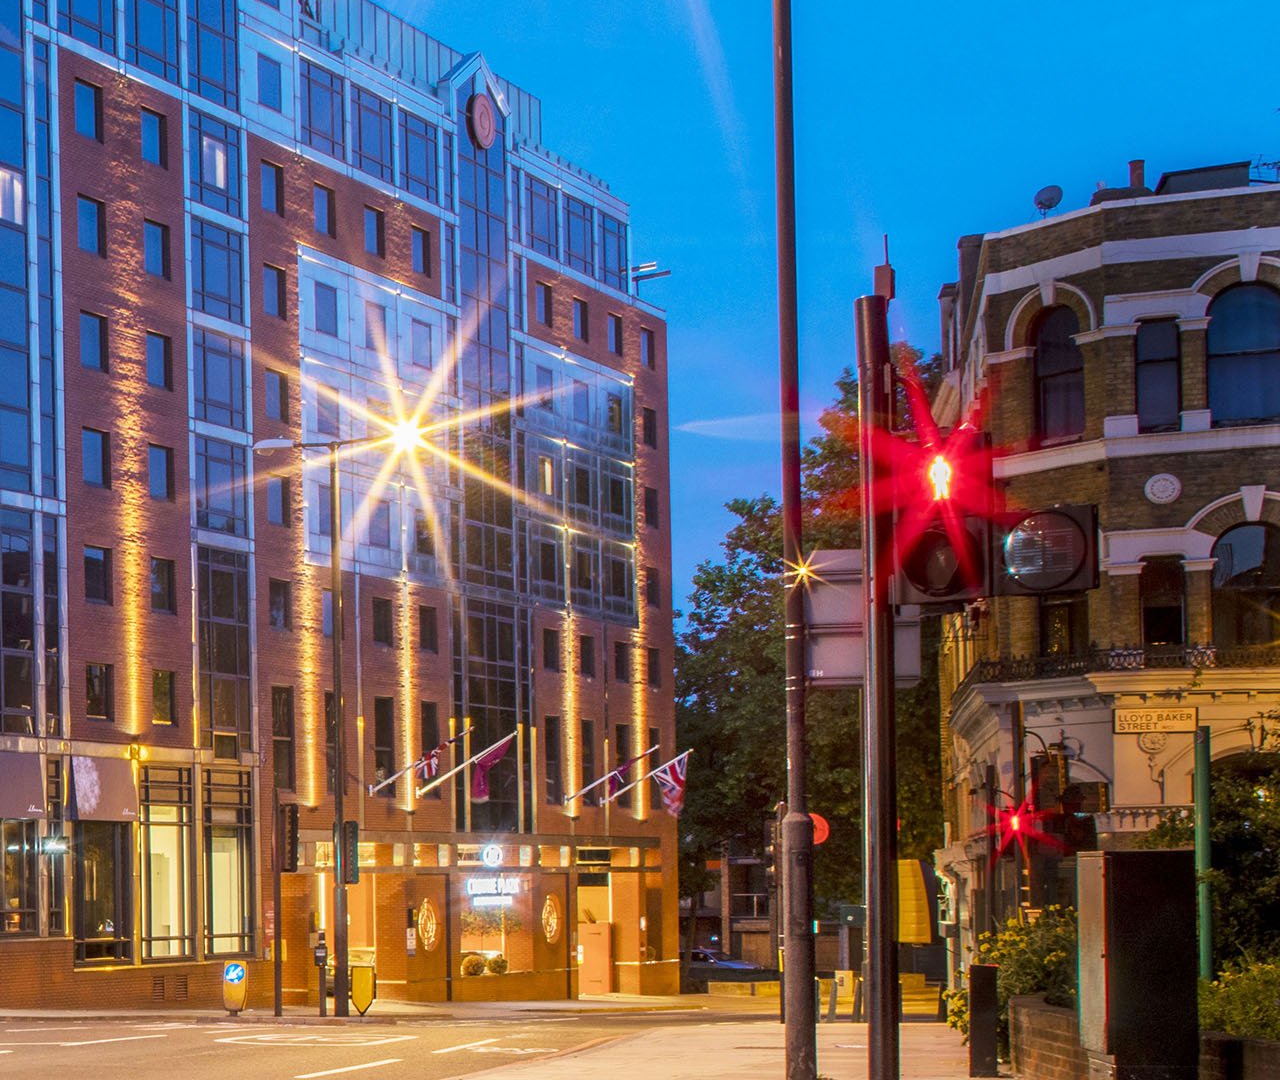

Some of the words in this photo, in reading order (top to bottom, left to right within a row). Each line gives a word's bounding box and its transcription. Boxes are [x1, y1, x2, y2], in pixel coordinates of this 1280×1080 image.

[1118, 714, 1153, 722] LLOYD
[1157, 713, 1193, 721] BAKER
[1119, 722, 1160, 731] STREET
